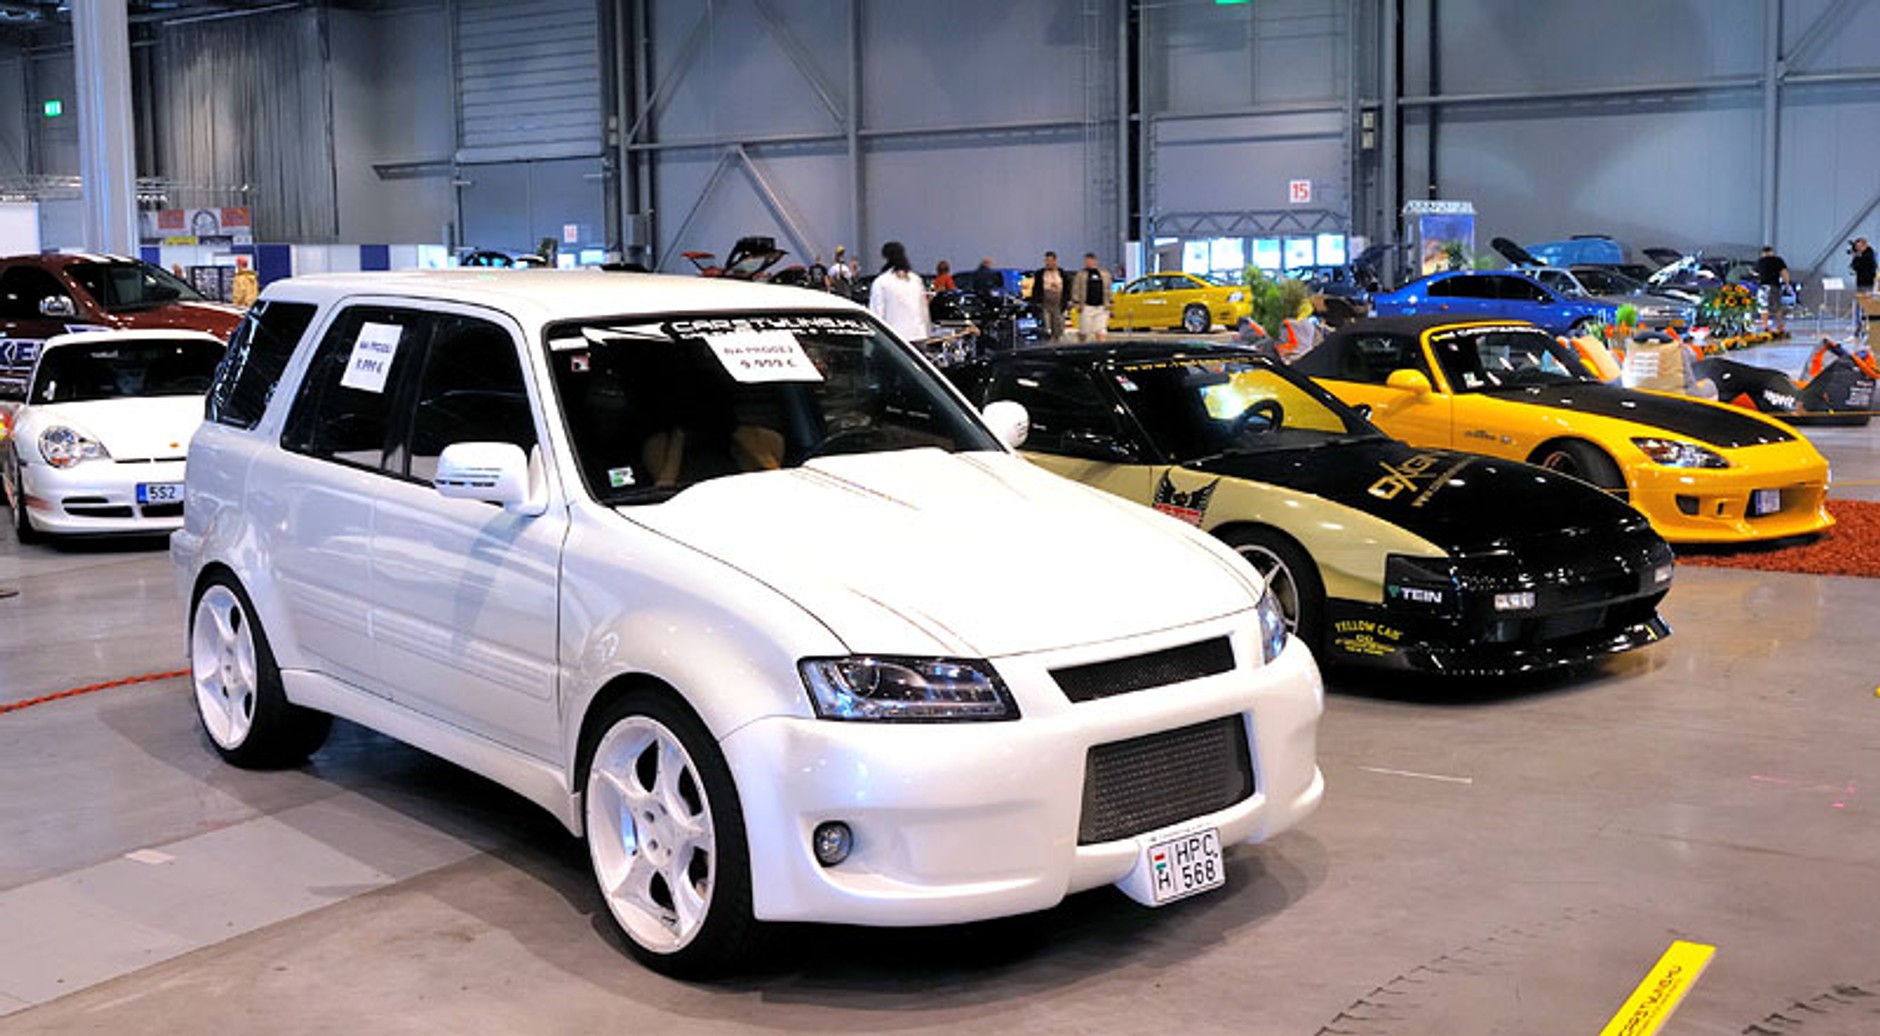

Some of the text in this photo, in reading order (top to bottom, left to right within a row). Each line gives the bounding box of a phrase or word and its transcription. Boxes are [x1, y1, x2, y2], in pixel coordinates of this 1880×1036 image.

[1293, 183, 1308, 200] 15
[1401, 587, 1442, 603] TEIN
[1335, 620, 1376, 633] YELLOW
[1157, 859, 1216, 889] H 568
